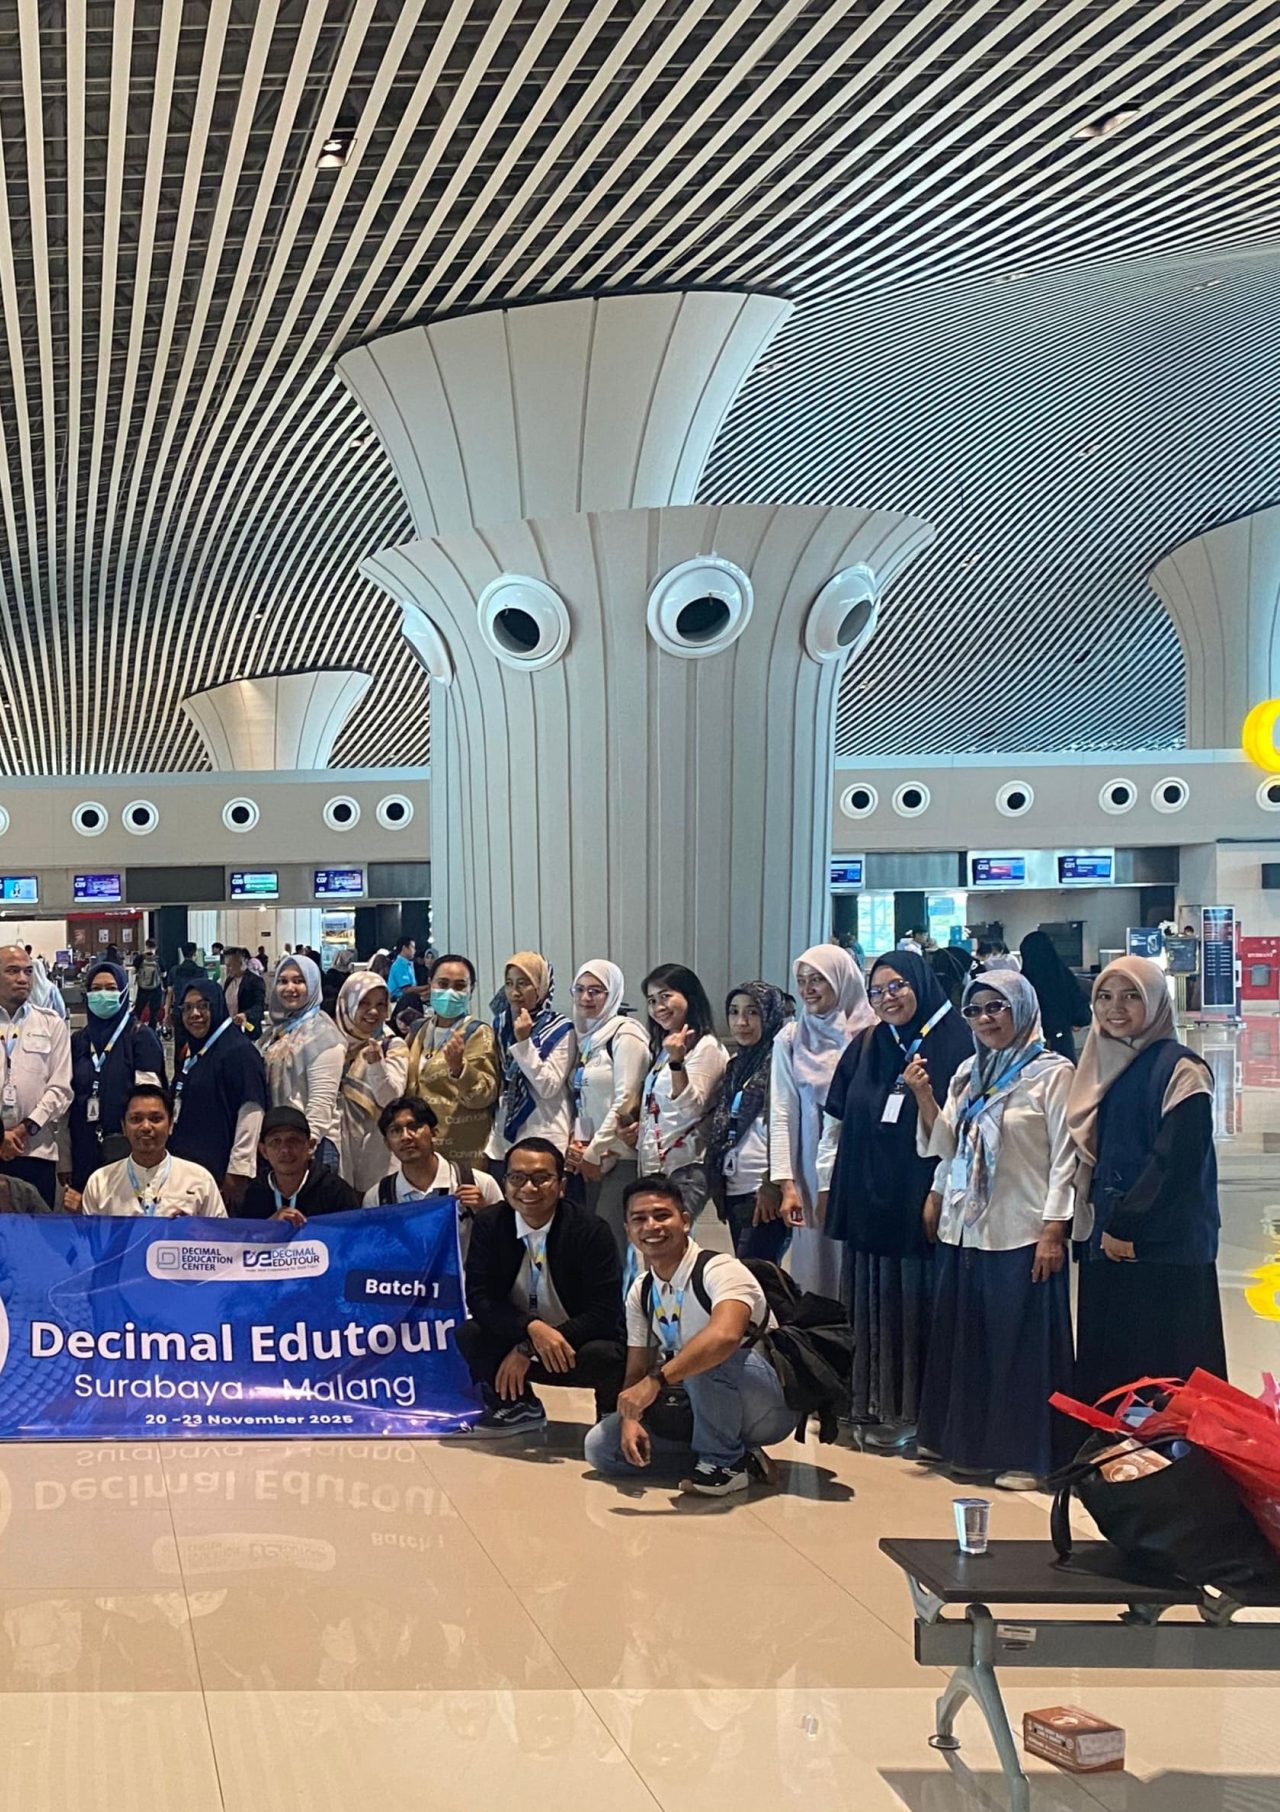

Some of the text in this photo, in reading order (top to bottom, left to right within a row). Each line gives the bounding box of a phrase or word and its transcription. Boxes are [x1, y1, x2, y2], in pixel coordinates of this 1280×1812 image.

[182, 1247, 221, 1256] DECIMAL
[272, 1247, 316, 1259] DECIMAL
[182, 1255, 233, 1264] EDUCATION
[272, 1255, 320, 1267] EDUTOUR
[182, 1263, 216, 1271] CENTER
[365, 1279, 440, 1299] Batch 1
[31, 1319, 456, 1363] Decimal Edutour
[75, 1373, 244, 1406] Surabaya
[283, 1374, 416, 1407] Malang
[145, 1414, 167, 1425] 20
[208, 1413, 305, 1425] November
[309, 1413, 354, 1424] 2025
